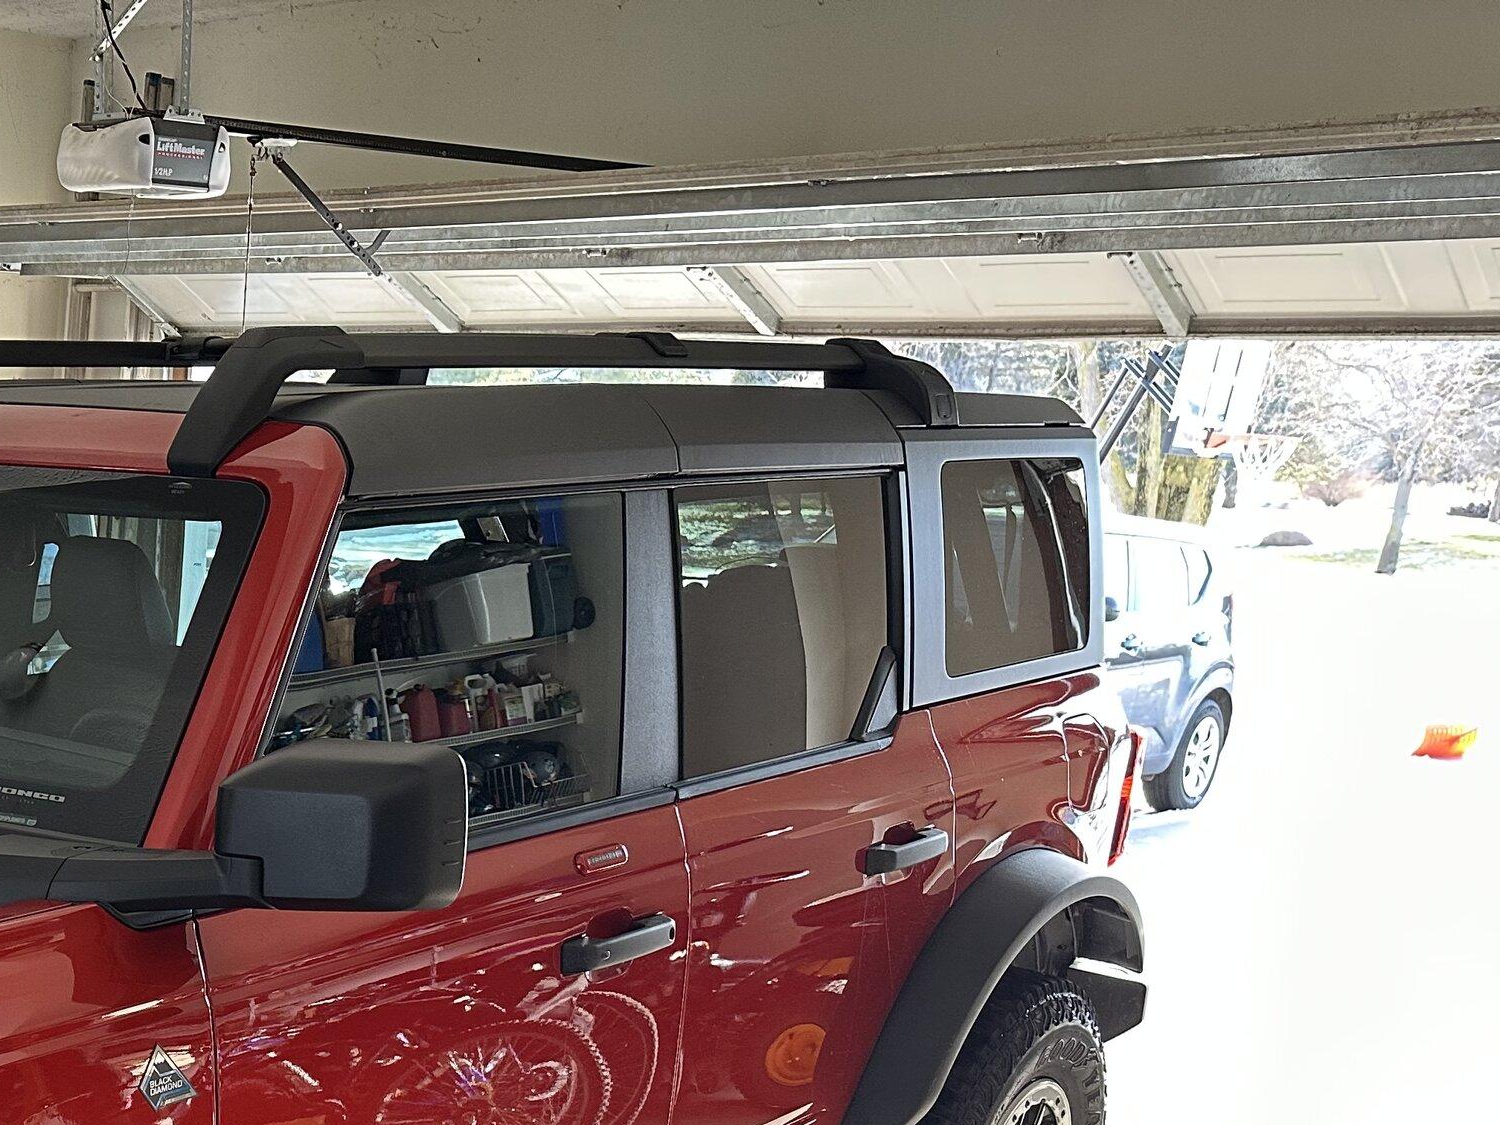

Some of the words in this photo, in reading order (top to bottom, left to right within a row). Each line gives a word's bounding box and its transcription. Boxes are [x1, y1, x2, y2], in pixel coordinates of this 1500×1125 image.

[157, 141, 205, 155] LiftMaster
[150, 1075, 172, 1088] BLACK
[150, 1080, 182, 1096] DIAMOND
